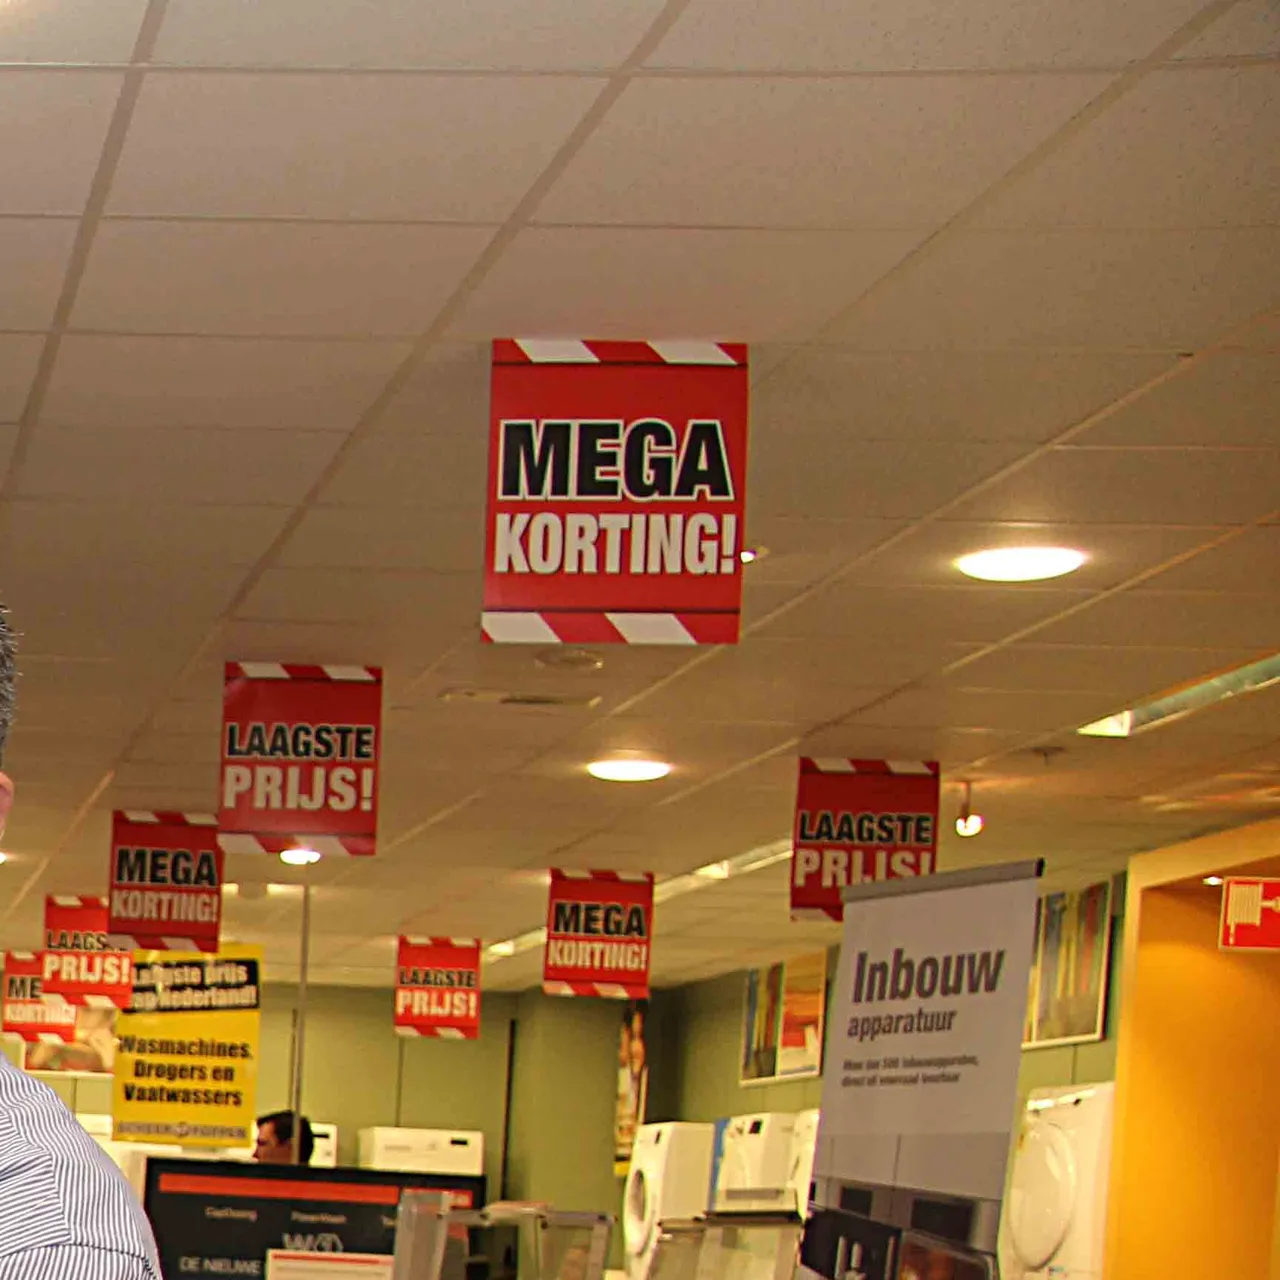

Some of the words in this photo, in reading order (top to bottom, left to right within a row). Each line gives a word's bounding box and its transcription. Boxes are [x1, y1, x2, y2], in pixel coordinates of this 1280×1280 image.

[497, 417, 736, 503] MEGA
[493, 511, 737, 575] KORTING!
[225, 721, 376, 761] LAAGSTE
[222, 765, 376, 812] PRIJS!
[798, 811, 936, 845] LAAGSTE
[115, 846, 218, 888] MEGA
[111, 889, 218, 923] KORTING!
[552, 902, 646, 938] MEGA
[43, 953, 131, 983] PRIJS!
[547, 939, 647, 971] KORTING!
[8, 976, 41, 999] ME
[399, 967, 477, 989] LAAGSTE
[852, 947, 1005, 1004] Inbouw
[396, 989, 477, 1018] PRIJS!
[847, 1007, 957, 1042] apparatuur
[134, 1058, 207, 1082] Drogers
[212, 1063, 235, 1082] en
[123, 1082, 243, 1107] Vaatwassers
[179, 1255, 203, 1272] DE
[204, 1258, 261, 1275] NIEUWE
